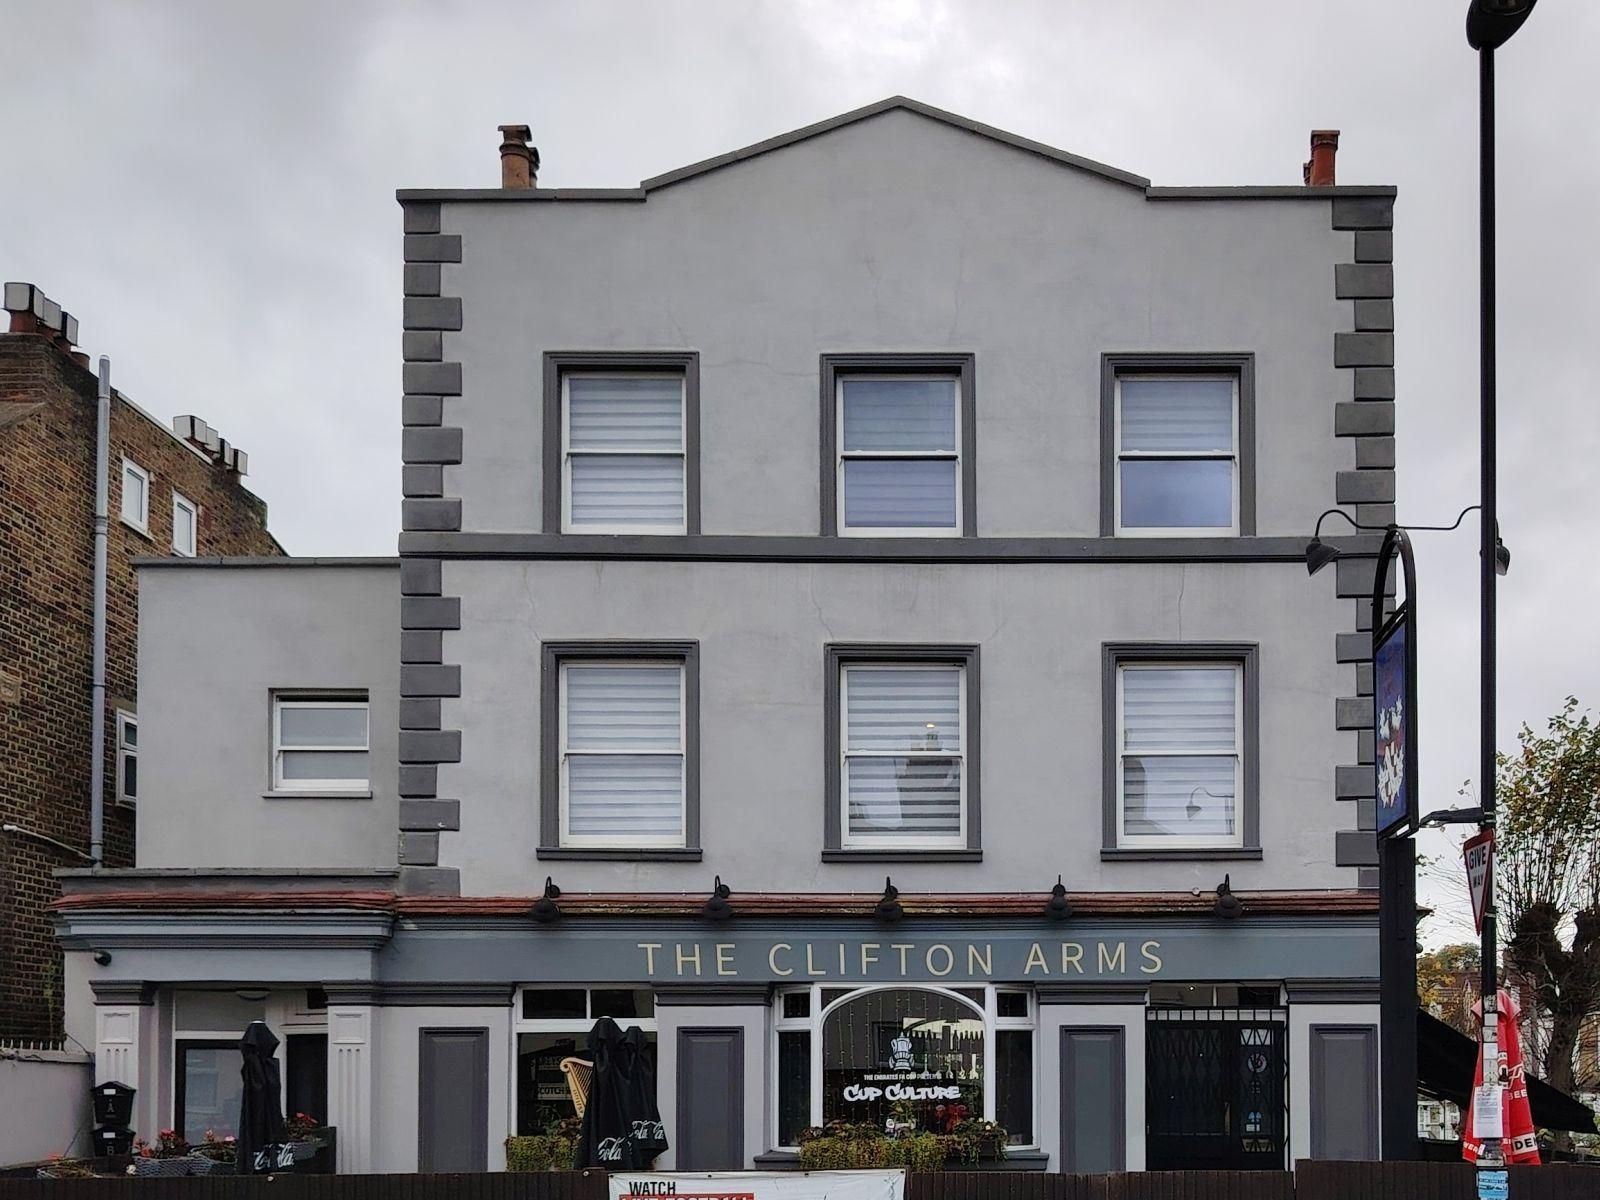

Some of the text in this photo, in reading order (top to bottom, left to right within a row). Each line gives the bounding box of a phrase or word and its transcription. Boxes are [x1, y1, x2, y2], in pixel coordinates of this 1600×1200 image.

[1469, 846, 1486, 870] GIVE
[637, 940, 1163, 976] THE CLIFTON ARMS
[628, 1181, 677, 1197] WATCH
